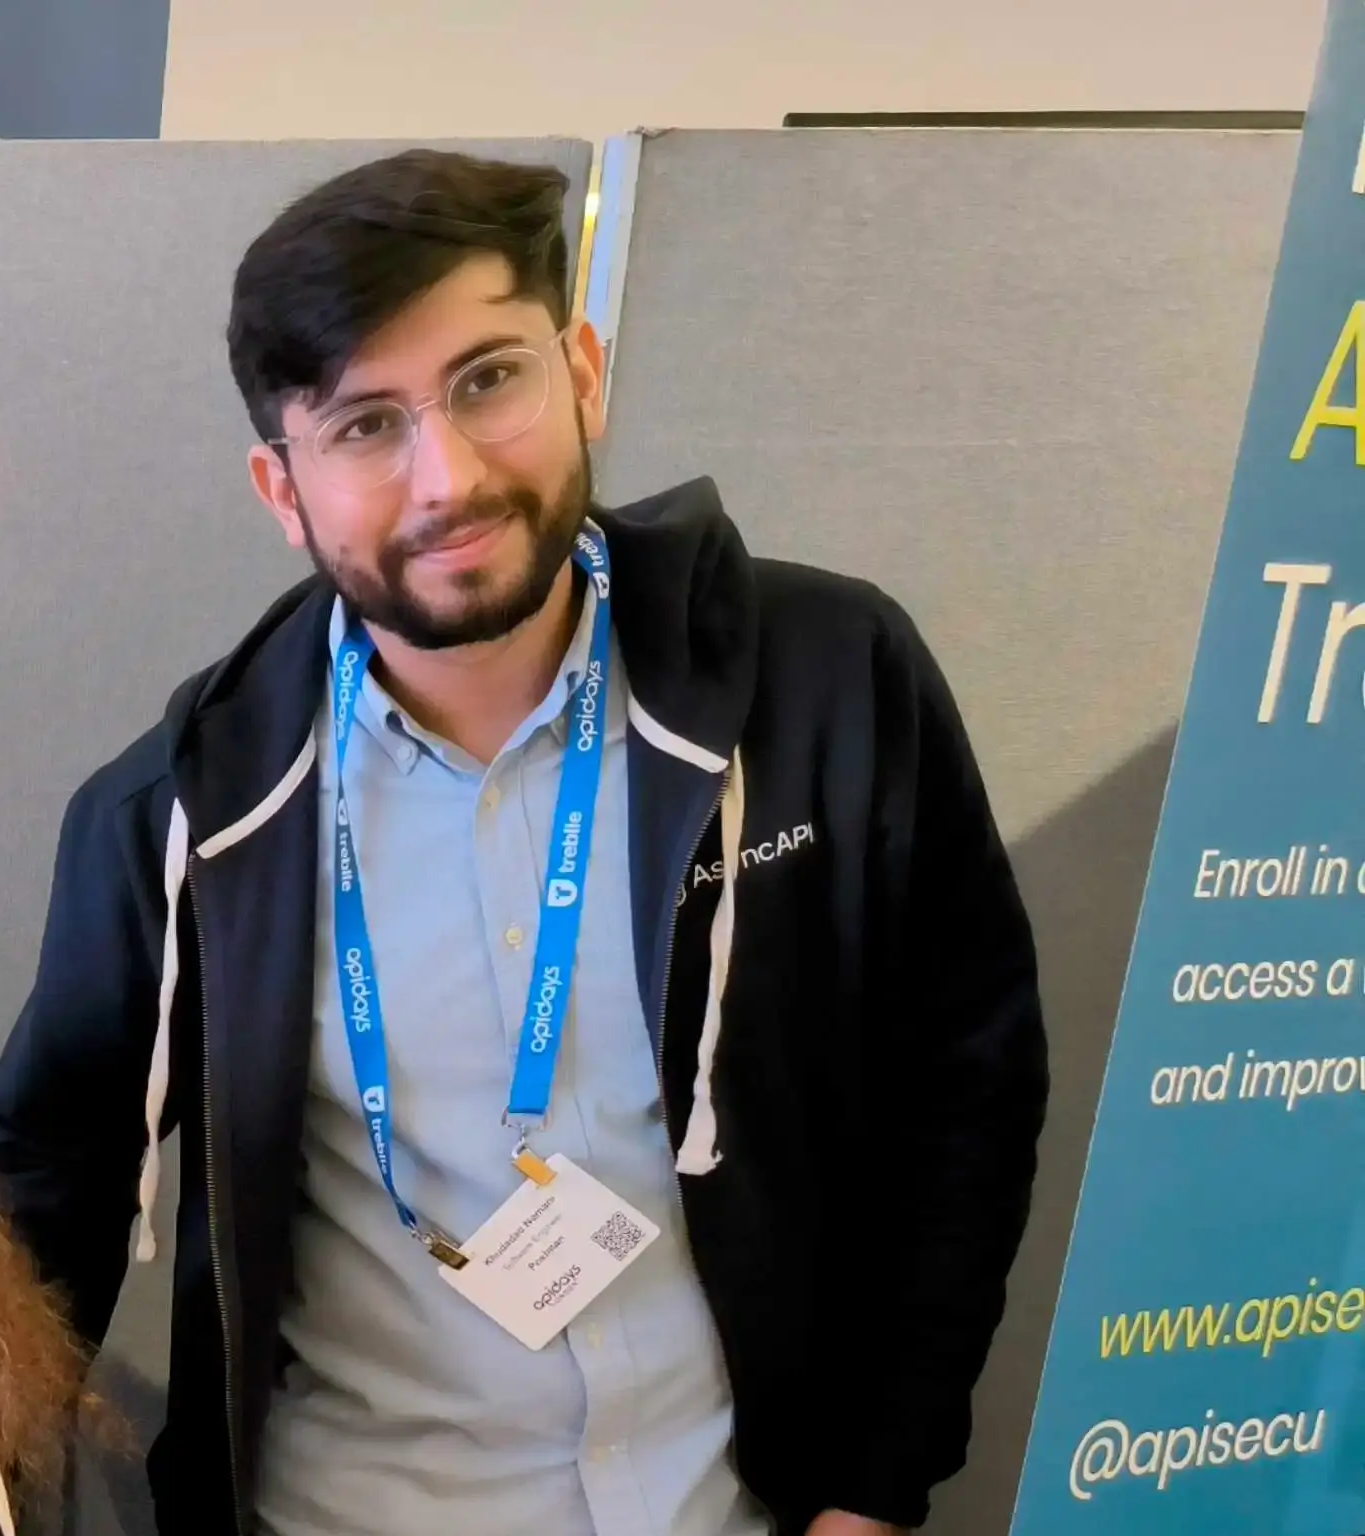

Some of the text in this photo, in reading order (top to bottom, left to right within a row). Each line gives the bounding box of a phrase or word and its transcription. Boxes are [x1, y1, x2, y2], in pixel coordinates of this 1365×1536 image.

[1258, 562, 1365, 725] Tr
[577, 659, 601, 752] apidays
[558, 810, 582, 874] treblle
[693, 822, 814, 888] AsncAPI
[1194, 846, 1306, 898] Enroll
[1311, 844, 1348, 895] in
[347, 946, 372, 1034] apidays
[530, 964, 560, 1054] apidays
[1172, 958, 1355, 1002] access a
[1151, 1049, 1365, 1112] and impro
[533, 1264, 582, 1311] apidays
[1101, 1277, 1365, 1358] www.apise
[1070, 1409, 1325, 1500] @apisecu
